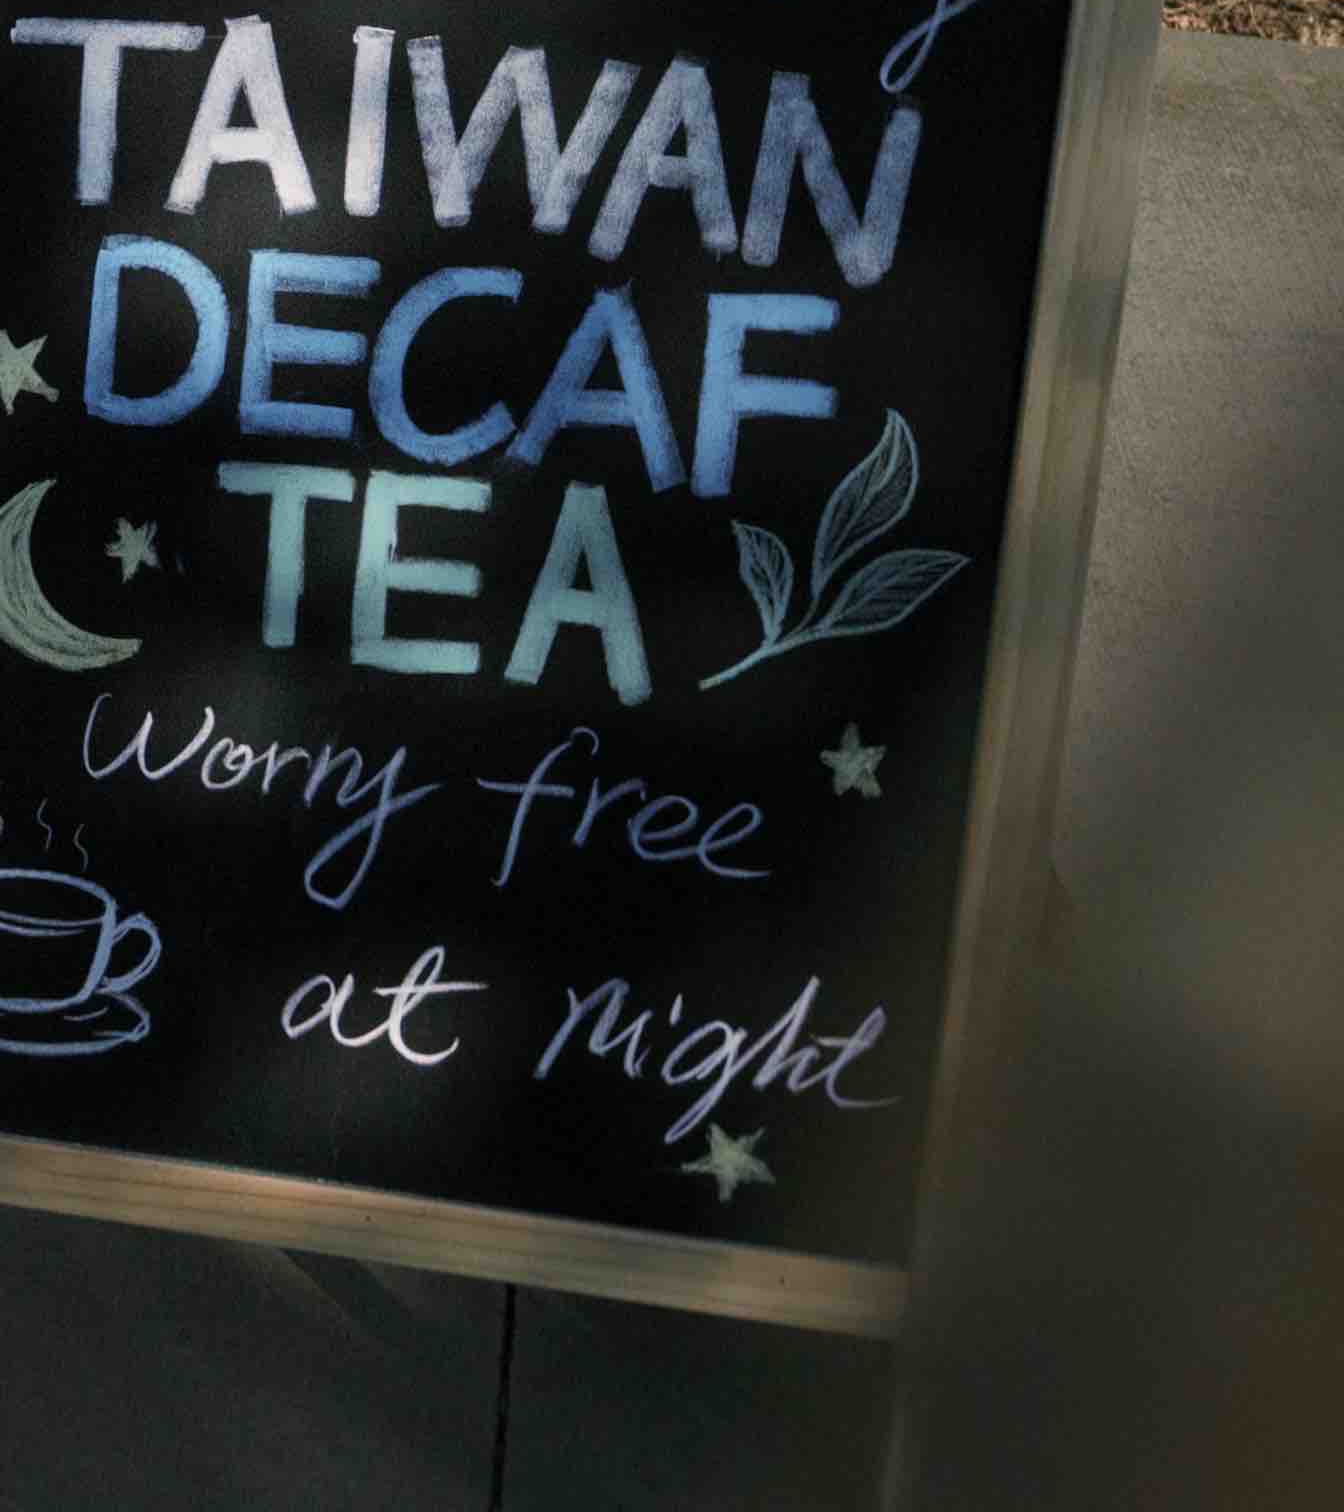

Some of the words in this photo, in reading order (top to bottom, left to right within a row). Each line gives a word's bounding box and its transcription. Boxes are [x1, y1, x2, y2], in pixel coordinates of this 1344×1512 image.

[10, 14, 922, 287] TAIWAN
[84, 233, 841, 497] DECAF
[218, 461, 653, 707] TEA
[82, 693, 444, 909] Worry
[476, 727, 771, 889] free
[280, 945, 489, 1065] at
[532, 975, 904, 1144] night
